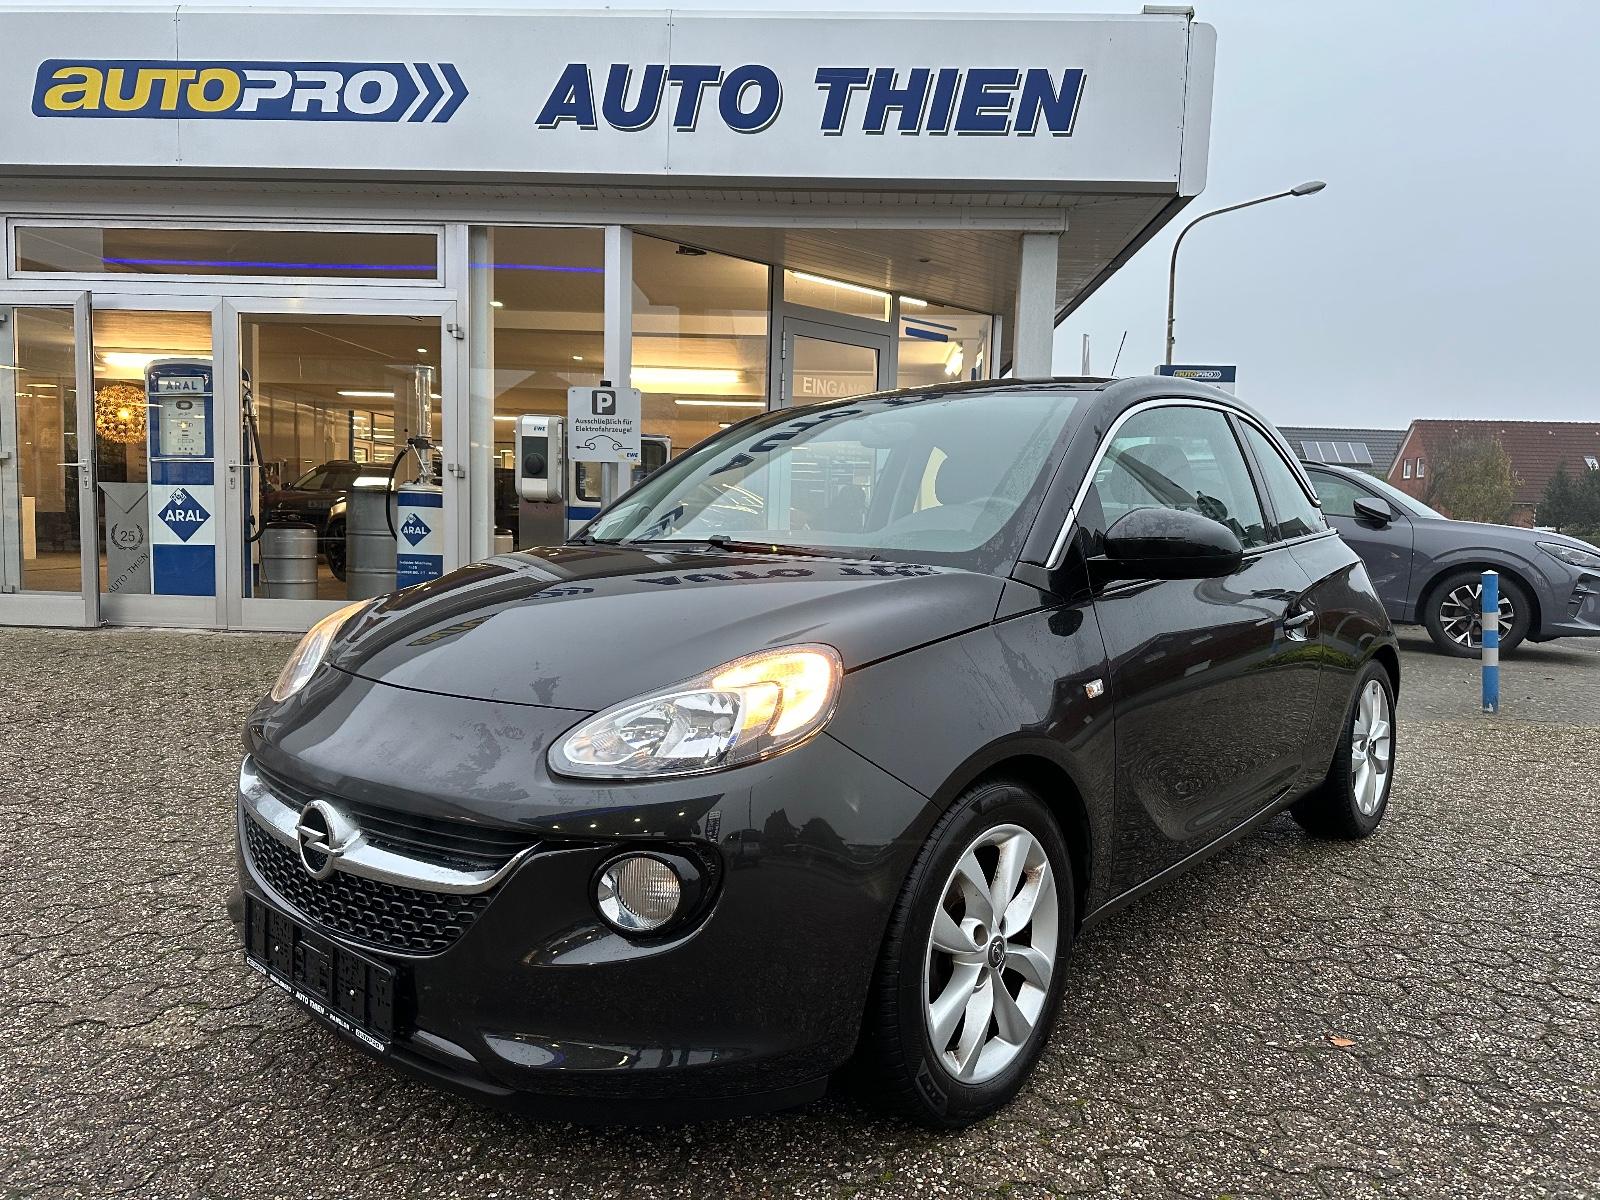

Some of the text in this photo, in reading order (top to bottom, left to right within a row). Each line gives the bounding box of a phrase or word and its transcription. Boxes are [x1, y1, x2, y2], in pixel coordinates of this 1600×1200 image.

[534, 63, 1087, 137] AUTO THIEN
[166, 380, 198, 391] ARAL
[596, 392, 613, 414] P
[575, 418, 633, 426] Ausschließlich für
[165, 510, 205, 522] ARAL
[403, 526, 428, 535] ARAL
[120, 531, 136, 542] 25
[108, 553, 149, 594] AUTO THIEN
